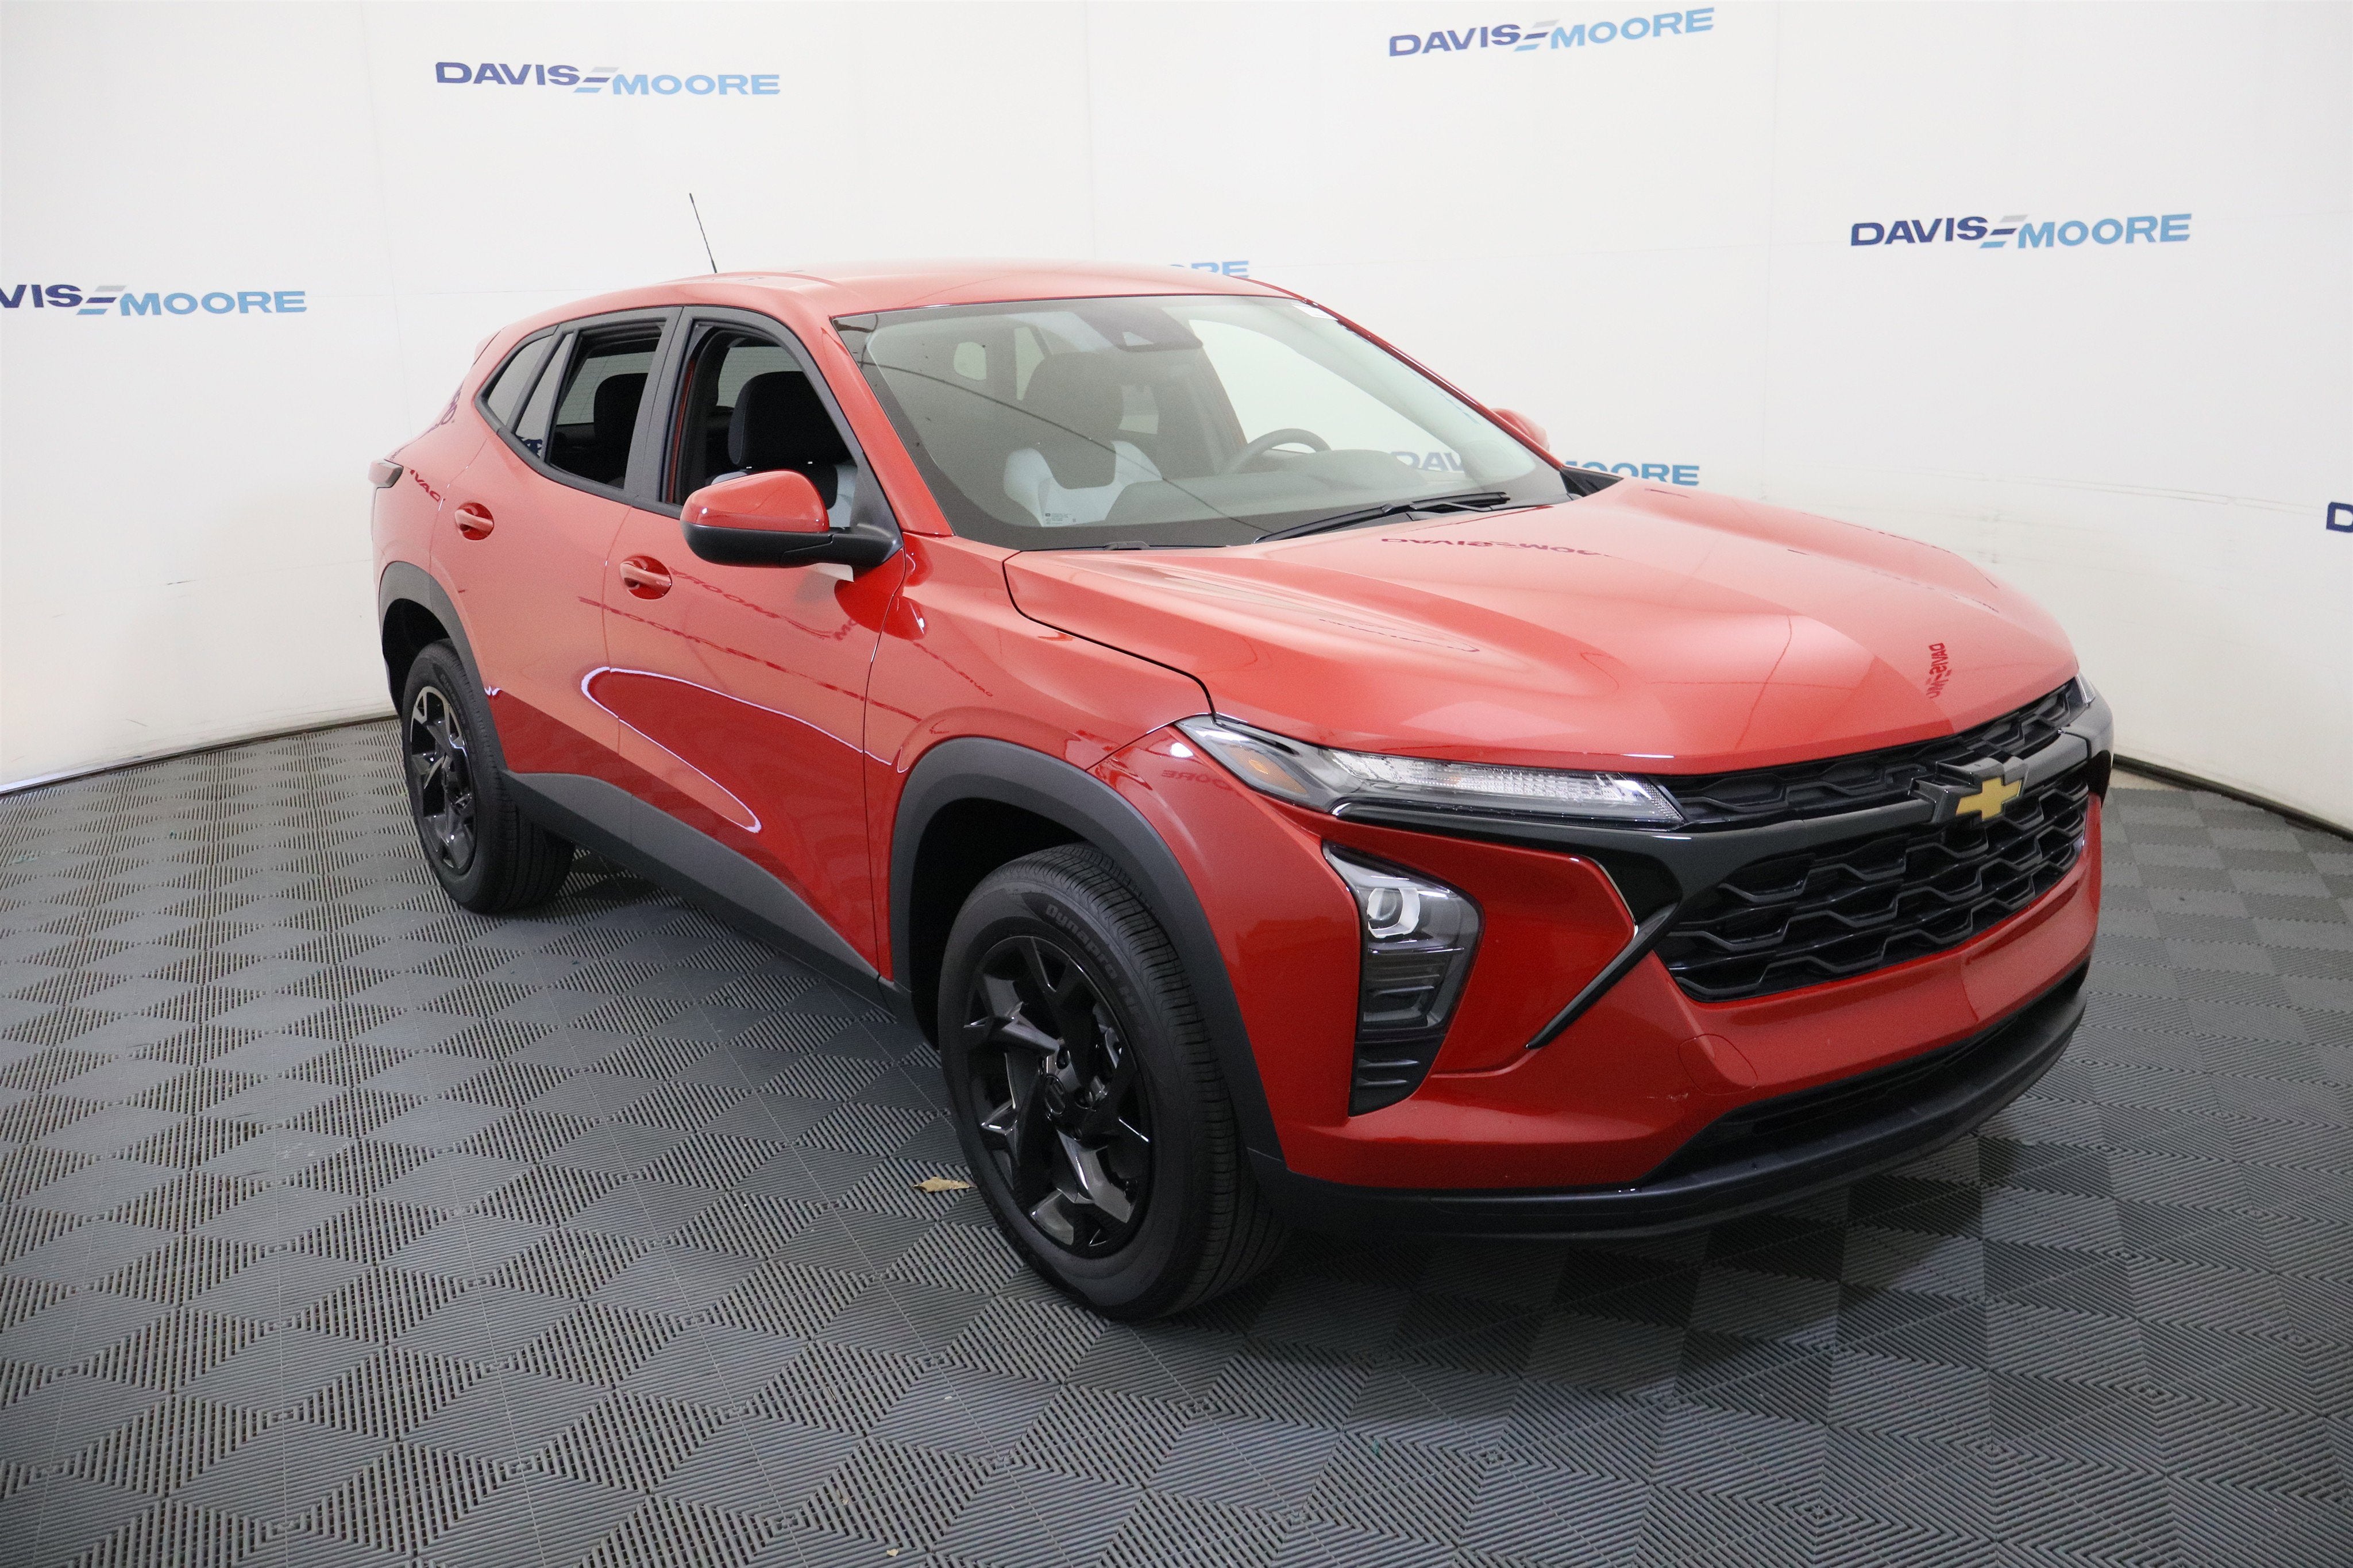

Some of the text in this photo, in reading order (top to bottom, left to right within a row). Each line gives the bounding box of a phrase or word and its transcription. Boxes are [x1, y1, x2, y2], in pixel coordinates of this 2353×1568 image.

[1388, 7, 1714, 57] DAVIS MOORE
[435, 62, 780, 95] DAVIS MOORE
[1850, 213, 2192, 249] DAVIS MOORE
[0, 284, 307, 316] VIS MOORE
[1046, 903, 1118, 979] Dynapro
